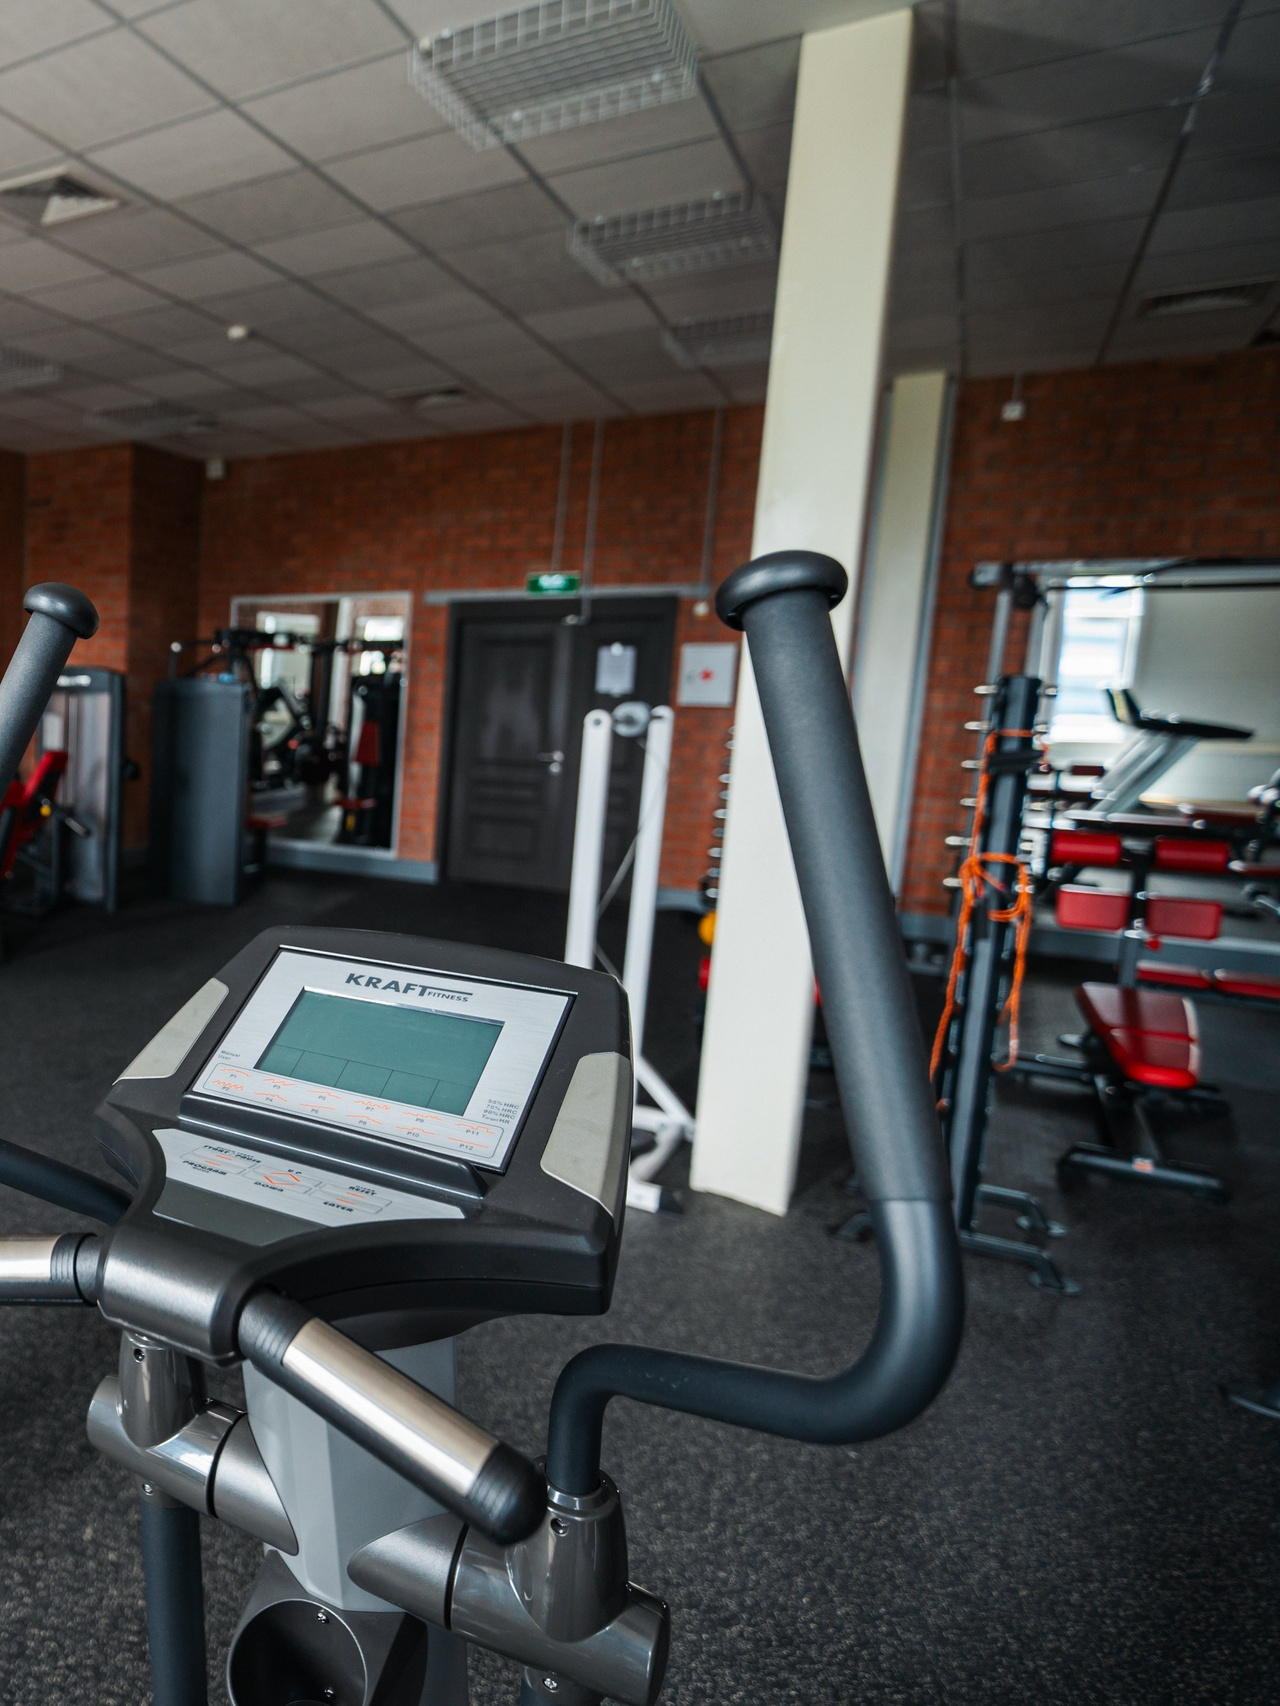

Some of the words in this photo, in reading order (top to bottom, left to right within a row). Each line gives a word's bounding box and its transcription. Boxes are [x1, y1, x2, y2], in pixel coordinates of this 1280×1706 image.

[345, 973, 429, 997] KRAFT
[427, 991, 469, 1002] FITNESS
[221, 1050, 241, 1058] Manual
[503, 1102, 520, 1110] HRC
[459, 1143, 474, 1151] P12
